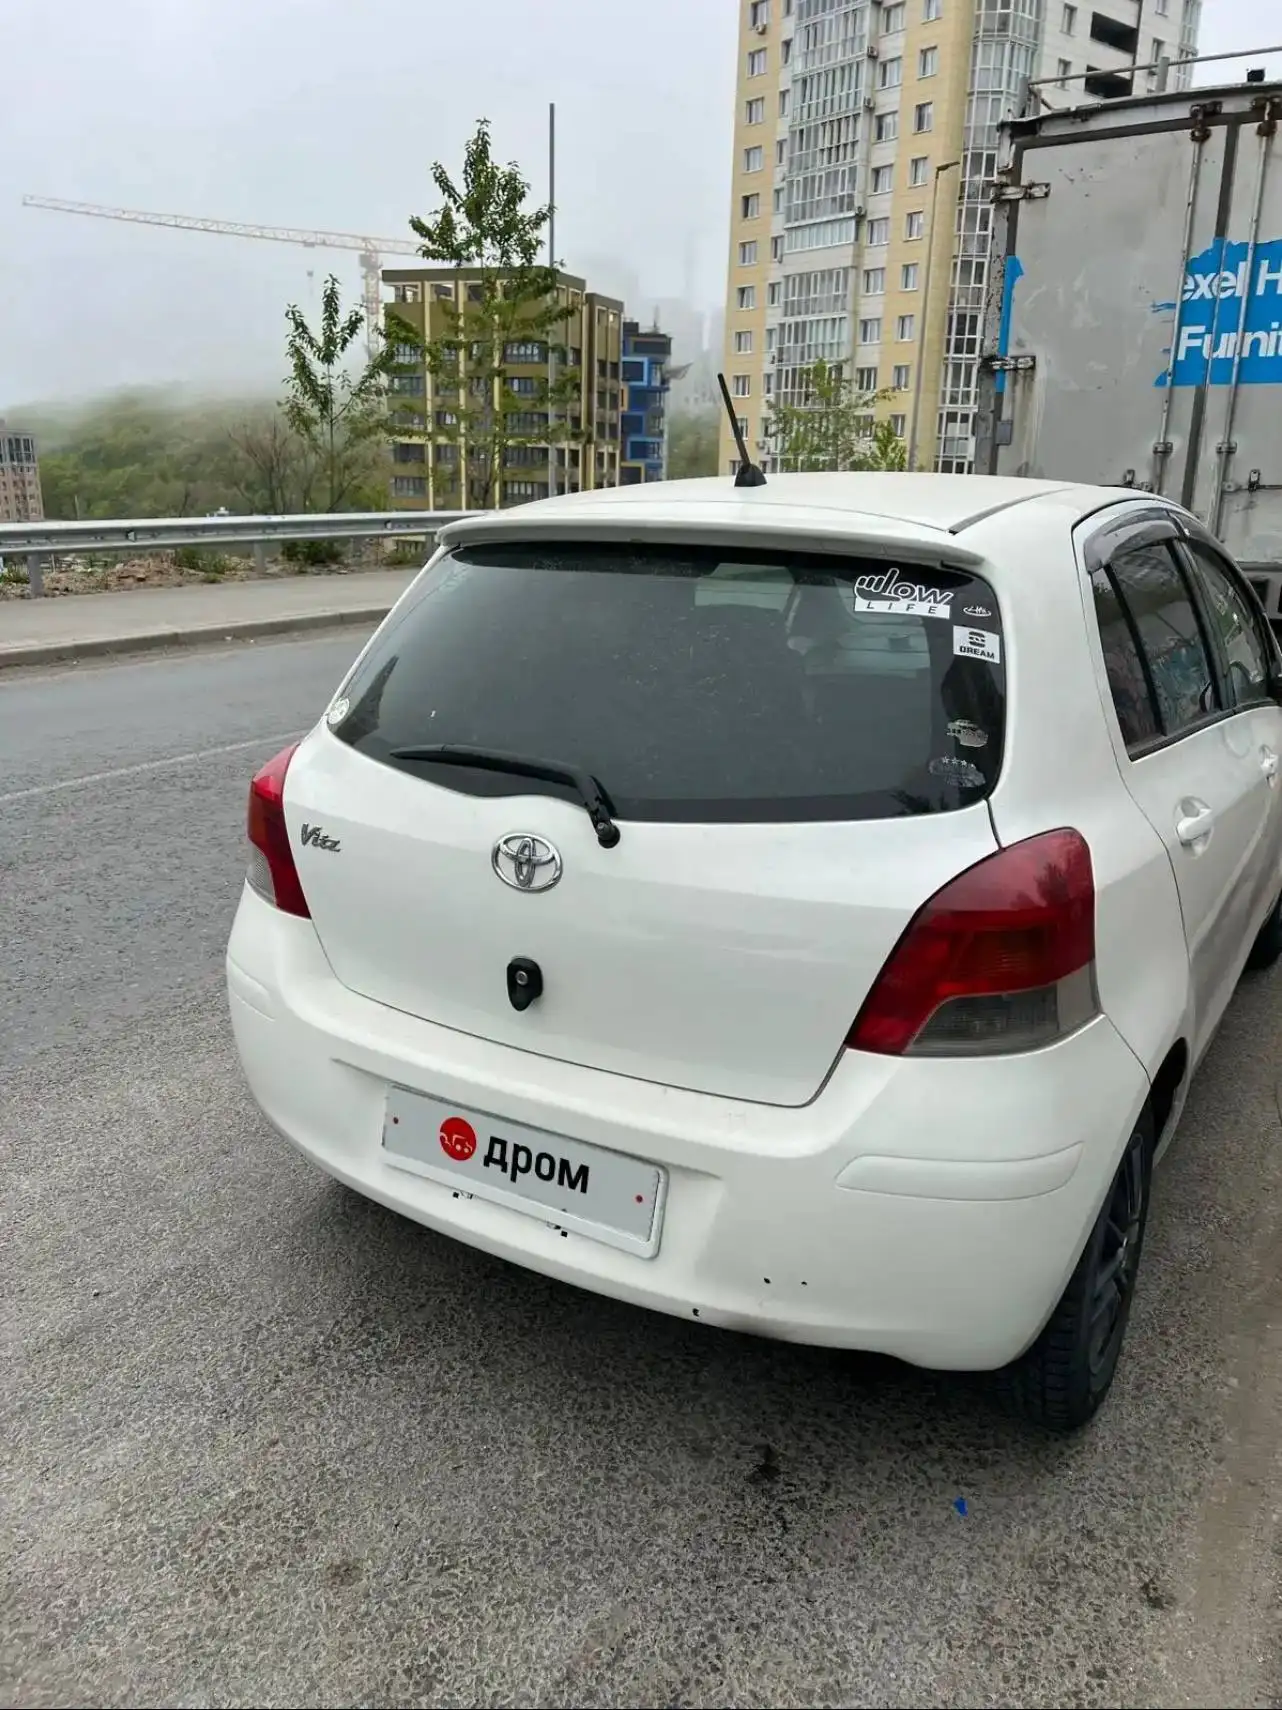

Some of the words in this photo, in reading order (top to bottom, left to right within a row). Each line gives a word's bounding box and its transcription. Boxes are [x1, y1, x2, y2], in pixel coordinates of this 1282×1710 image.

[866, 600, 938, 615] LIFE
[959, 645, 995, 660] DREAM
[301, 823, 341, 853] Vitz
